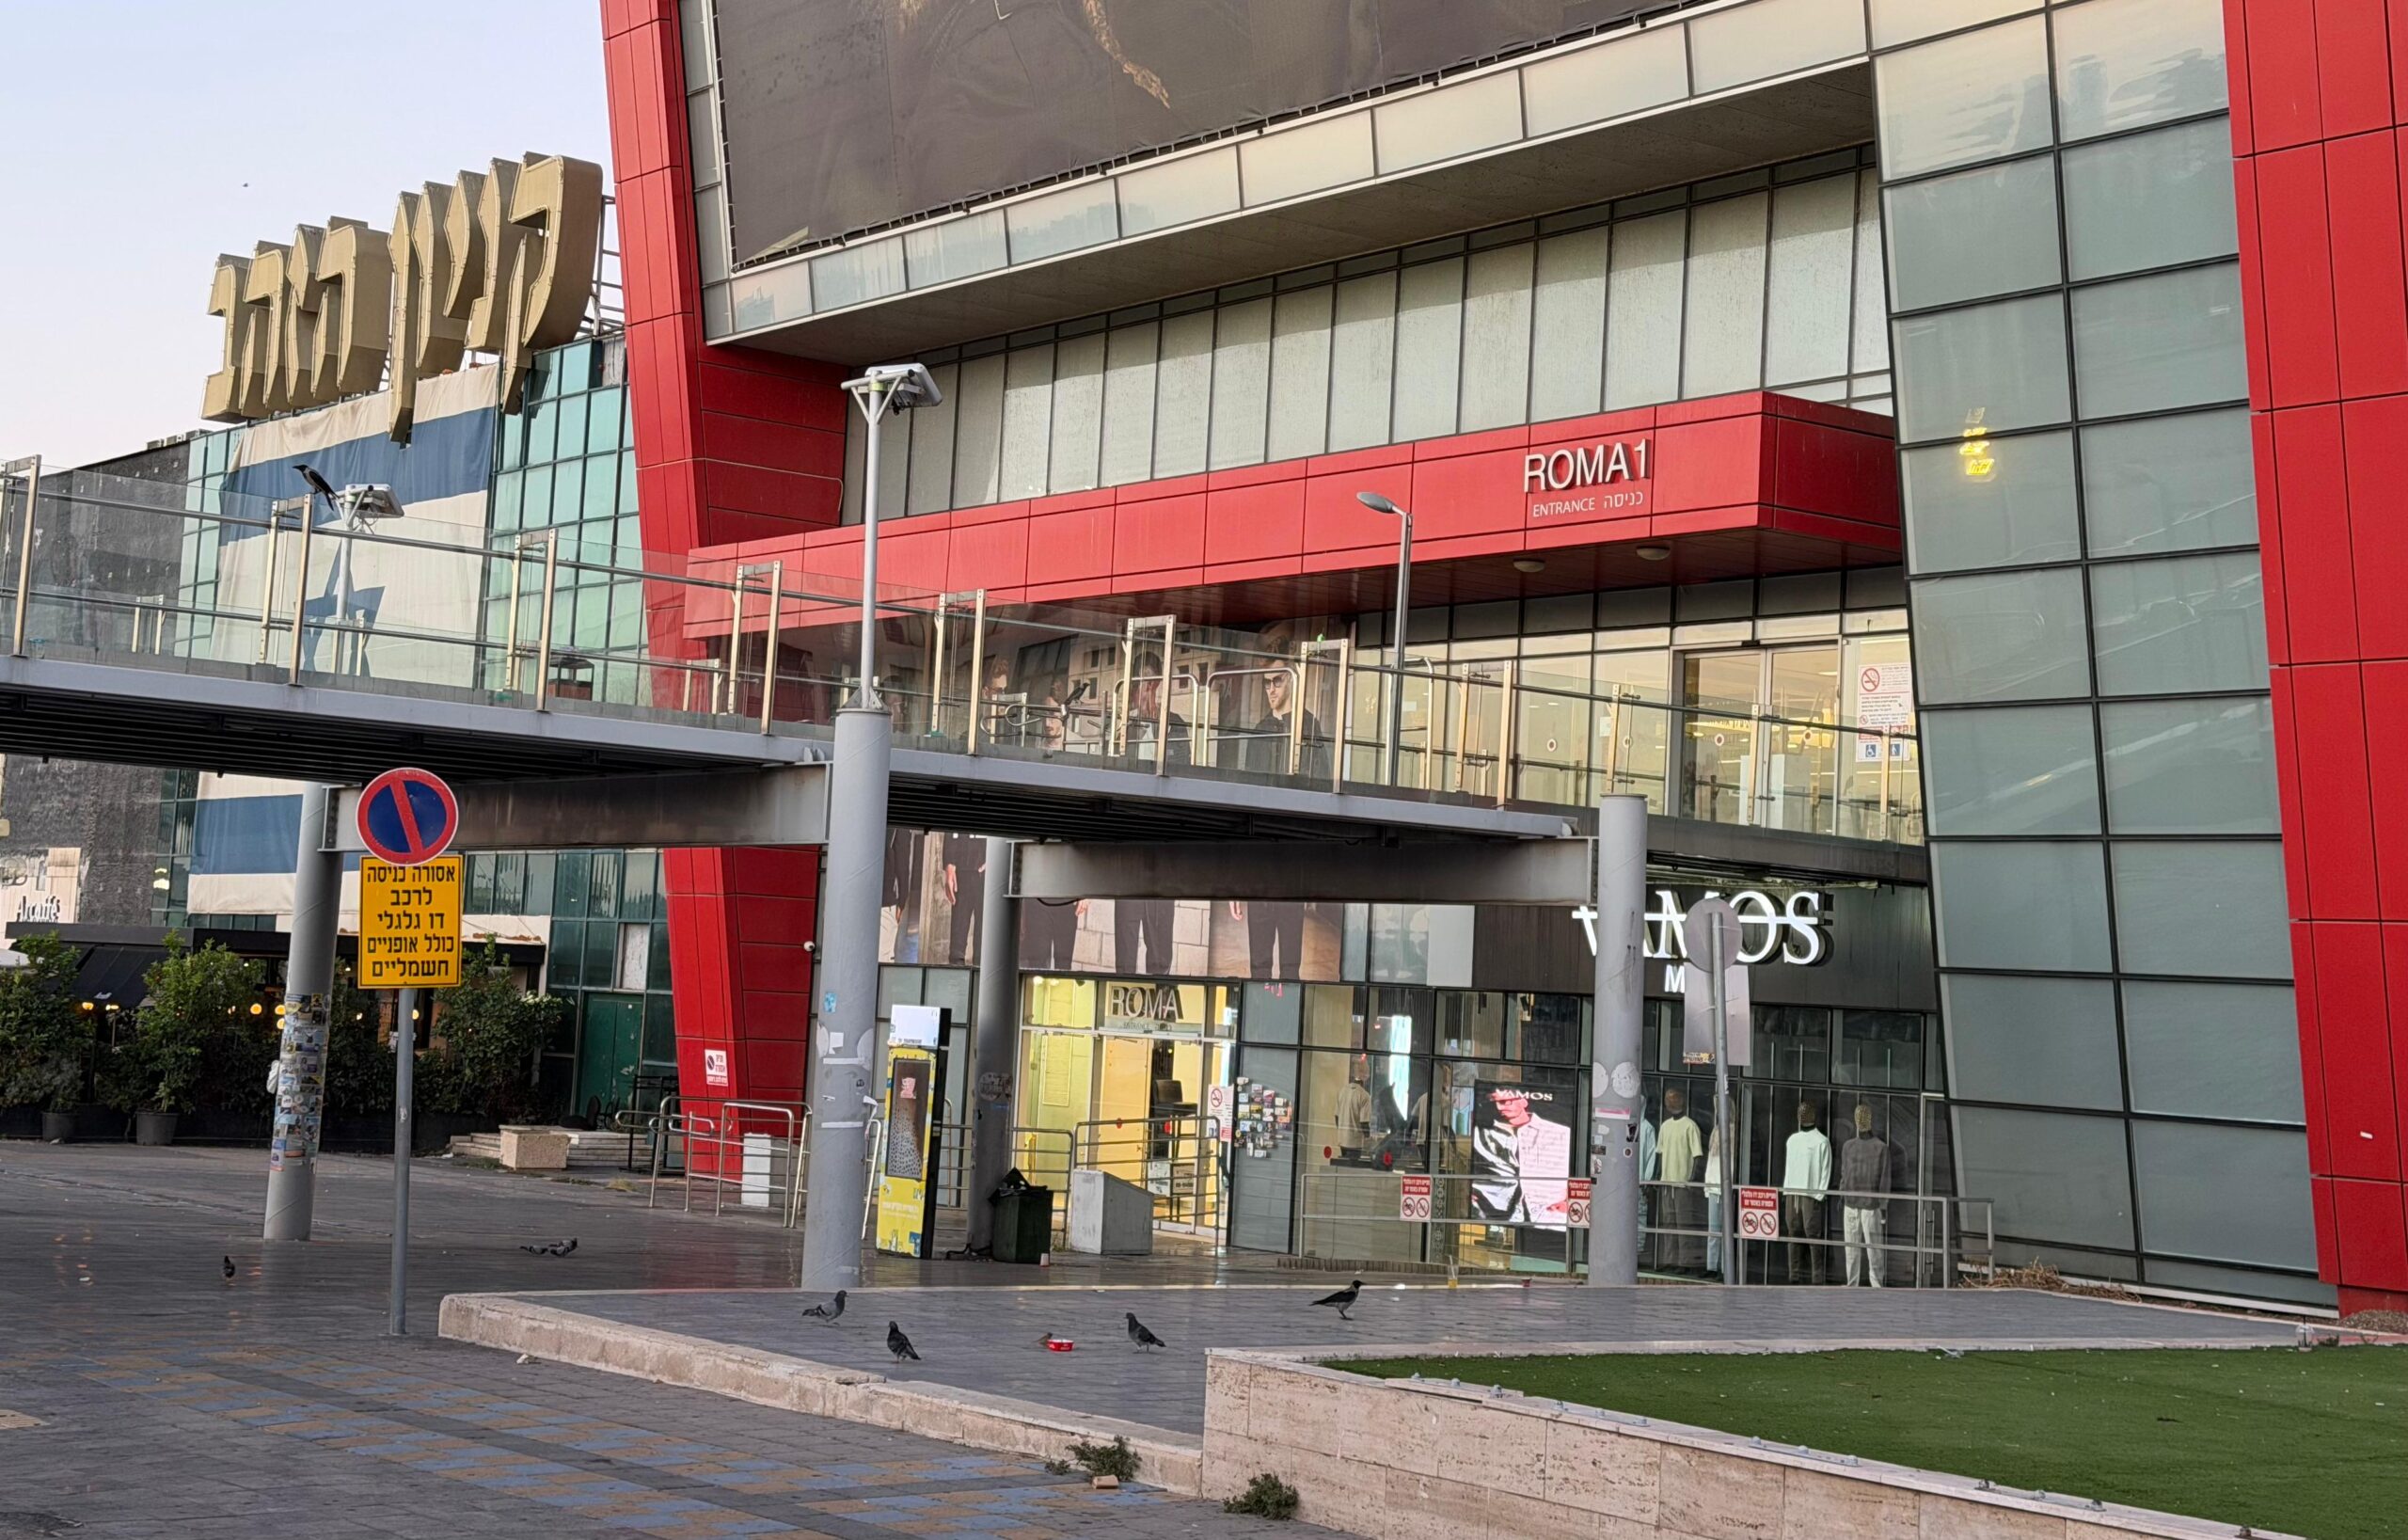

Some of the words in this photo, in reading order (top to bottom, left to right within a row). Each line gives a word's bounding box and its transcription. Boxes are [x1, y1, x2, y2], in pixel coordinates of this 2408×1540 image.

[1532, 497, 1596, 517] ENTRANCE
[1603, 491, 1644, 509] כניסה
[367, 865, 406, 882] כניסה
[412, 865, 455, 882] אסורה
[390, 886, 433, 906] לרכב
[377, 910, 421, 929] גלגלי
[429, 913, 445, 929] דו
[1572, 889, 1822, 965] VMOS
[367, 936, 419, 954] אופניים
[424, 934, 454, 952] כולל
[372, 958, 450, 977] חשמליים
[1111, 986, 1180, 1021] ROMA
[1496, 1088, 1553, 1102] VAMOS
